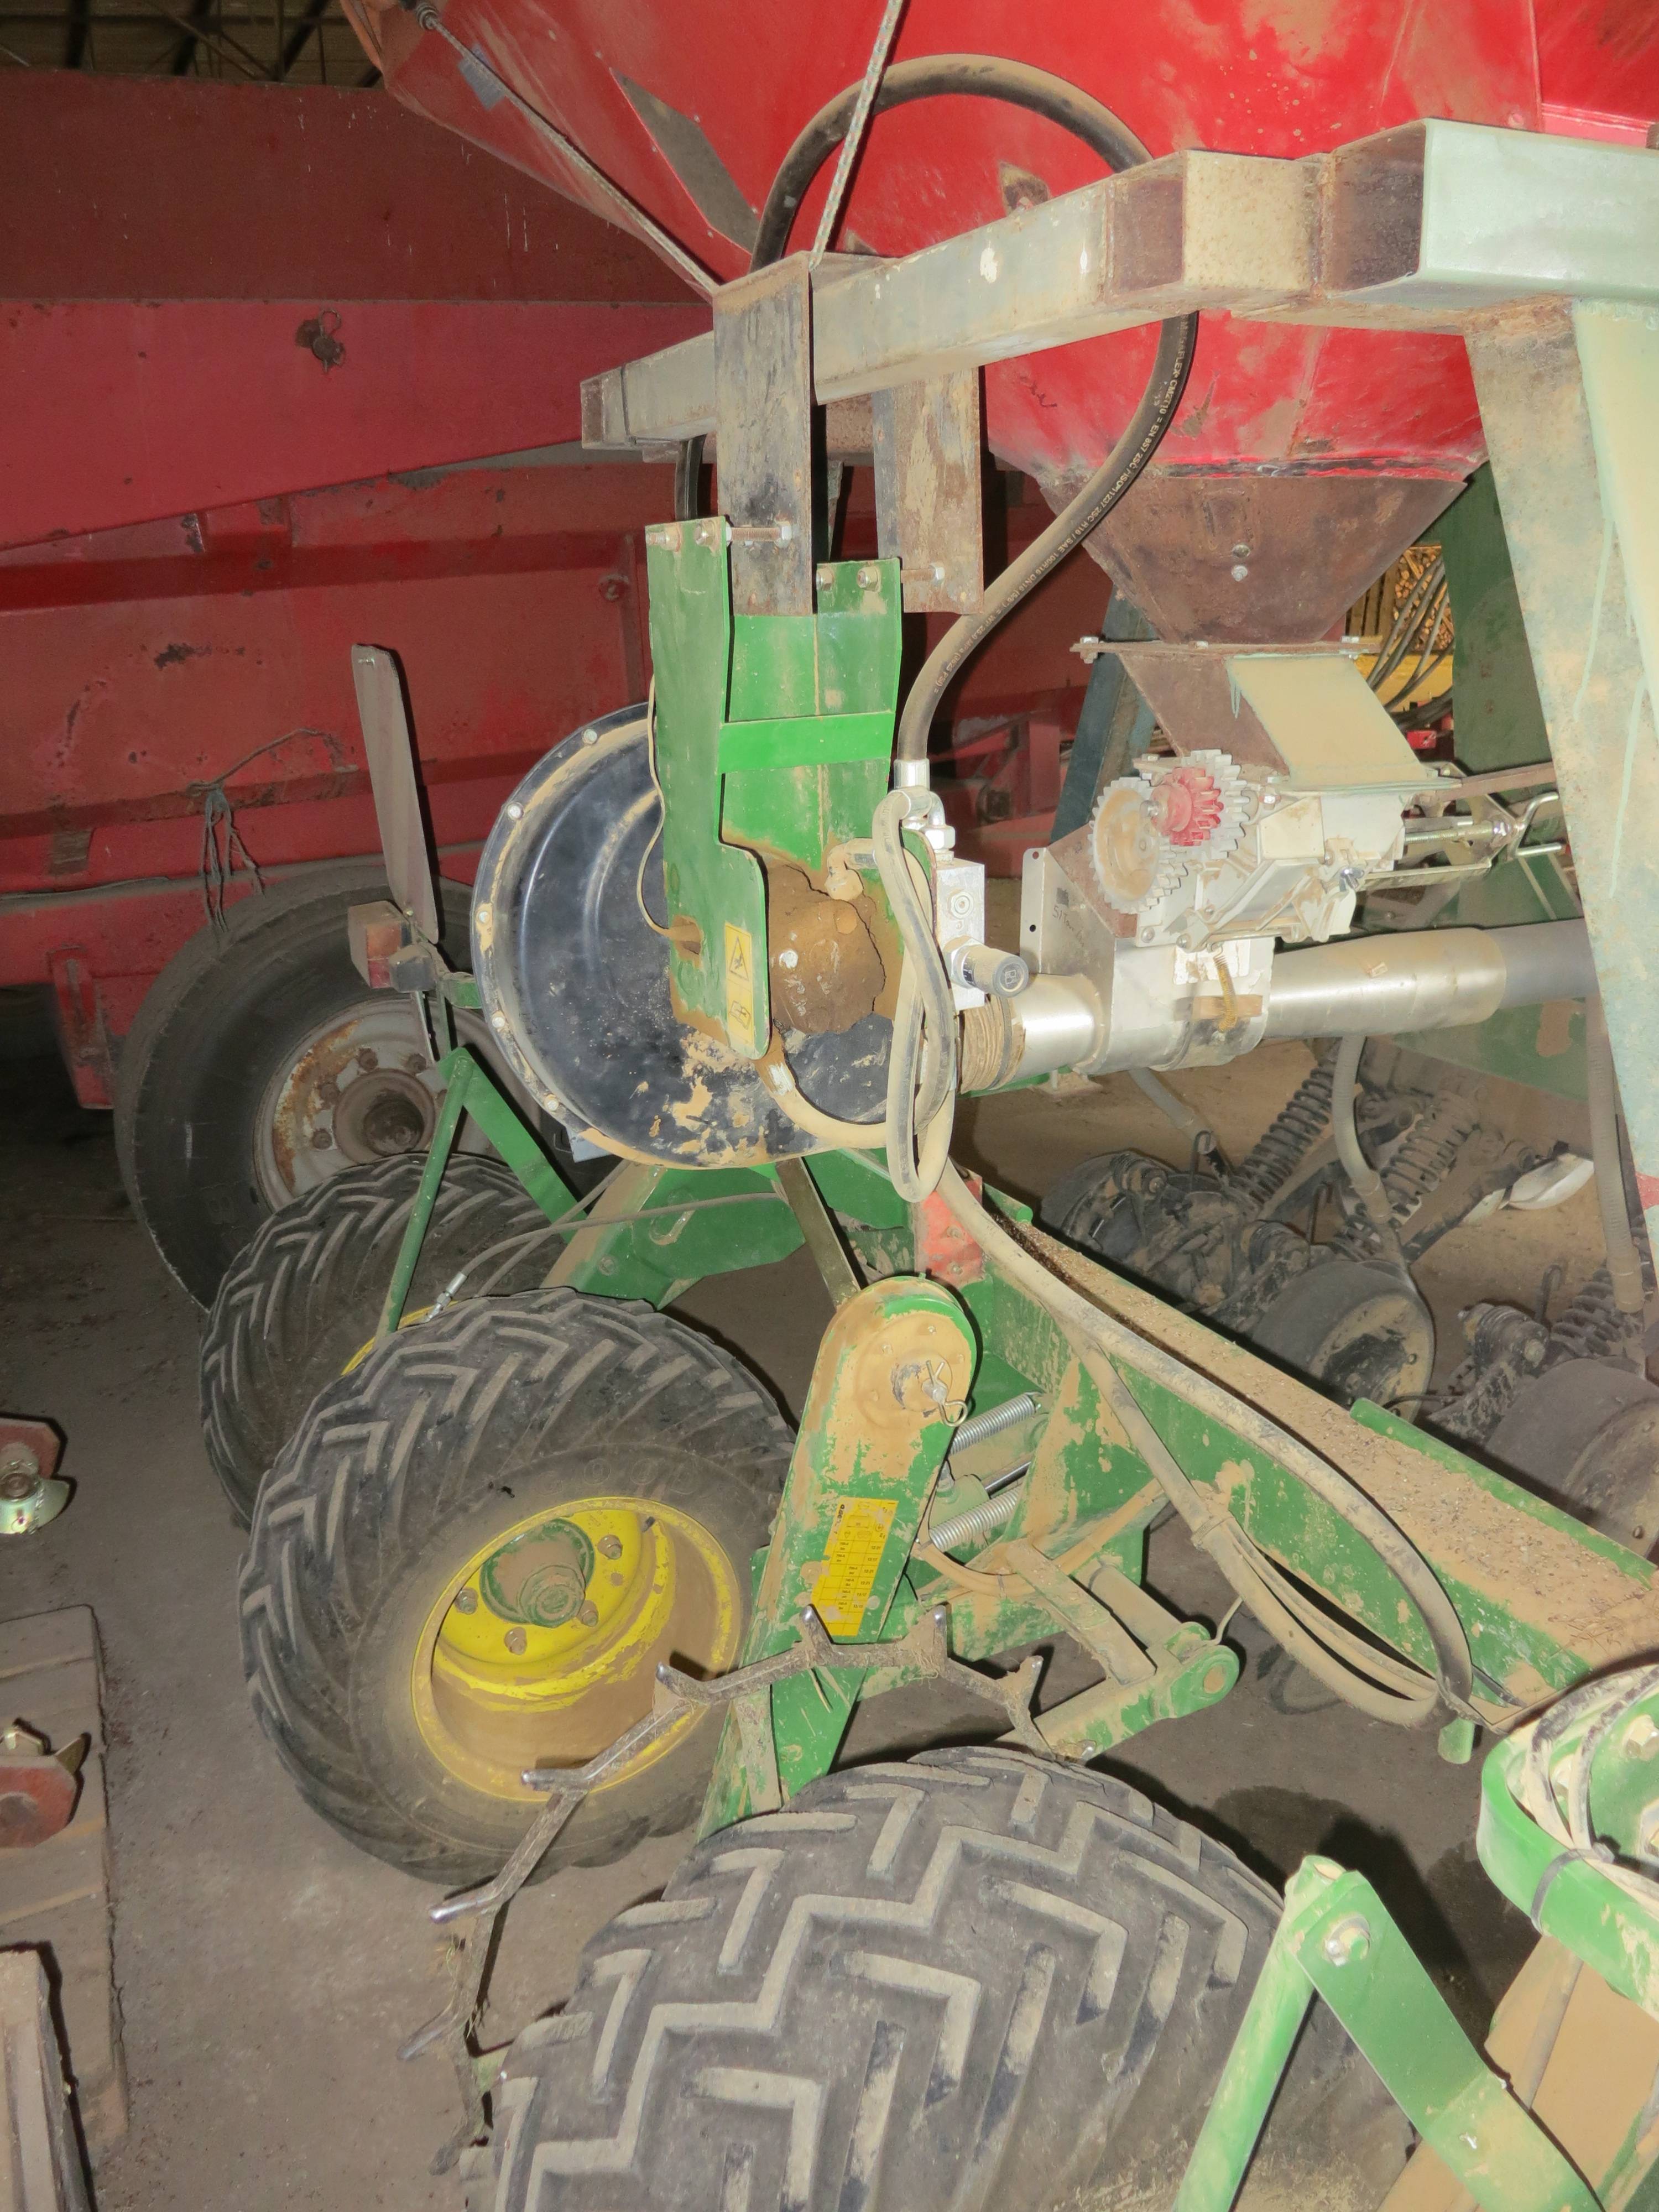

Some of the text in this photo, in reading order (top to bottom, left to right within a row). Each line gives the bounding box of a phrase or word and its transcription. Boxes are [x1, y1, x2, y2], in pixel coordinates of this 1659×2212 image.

[1148, 424, 1160, 437] EN
[1140, 437, 1152, 452] 857
[1129, 452, 1143, 469] 2SC
[1087, 506, 1102, 522] 2SC
[1057, 538, 1073, 553] SAE
